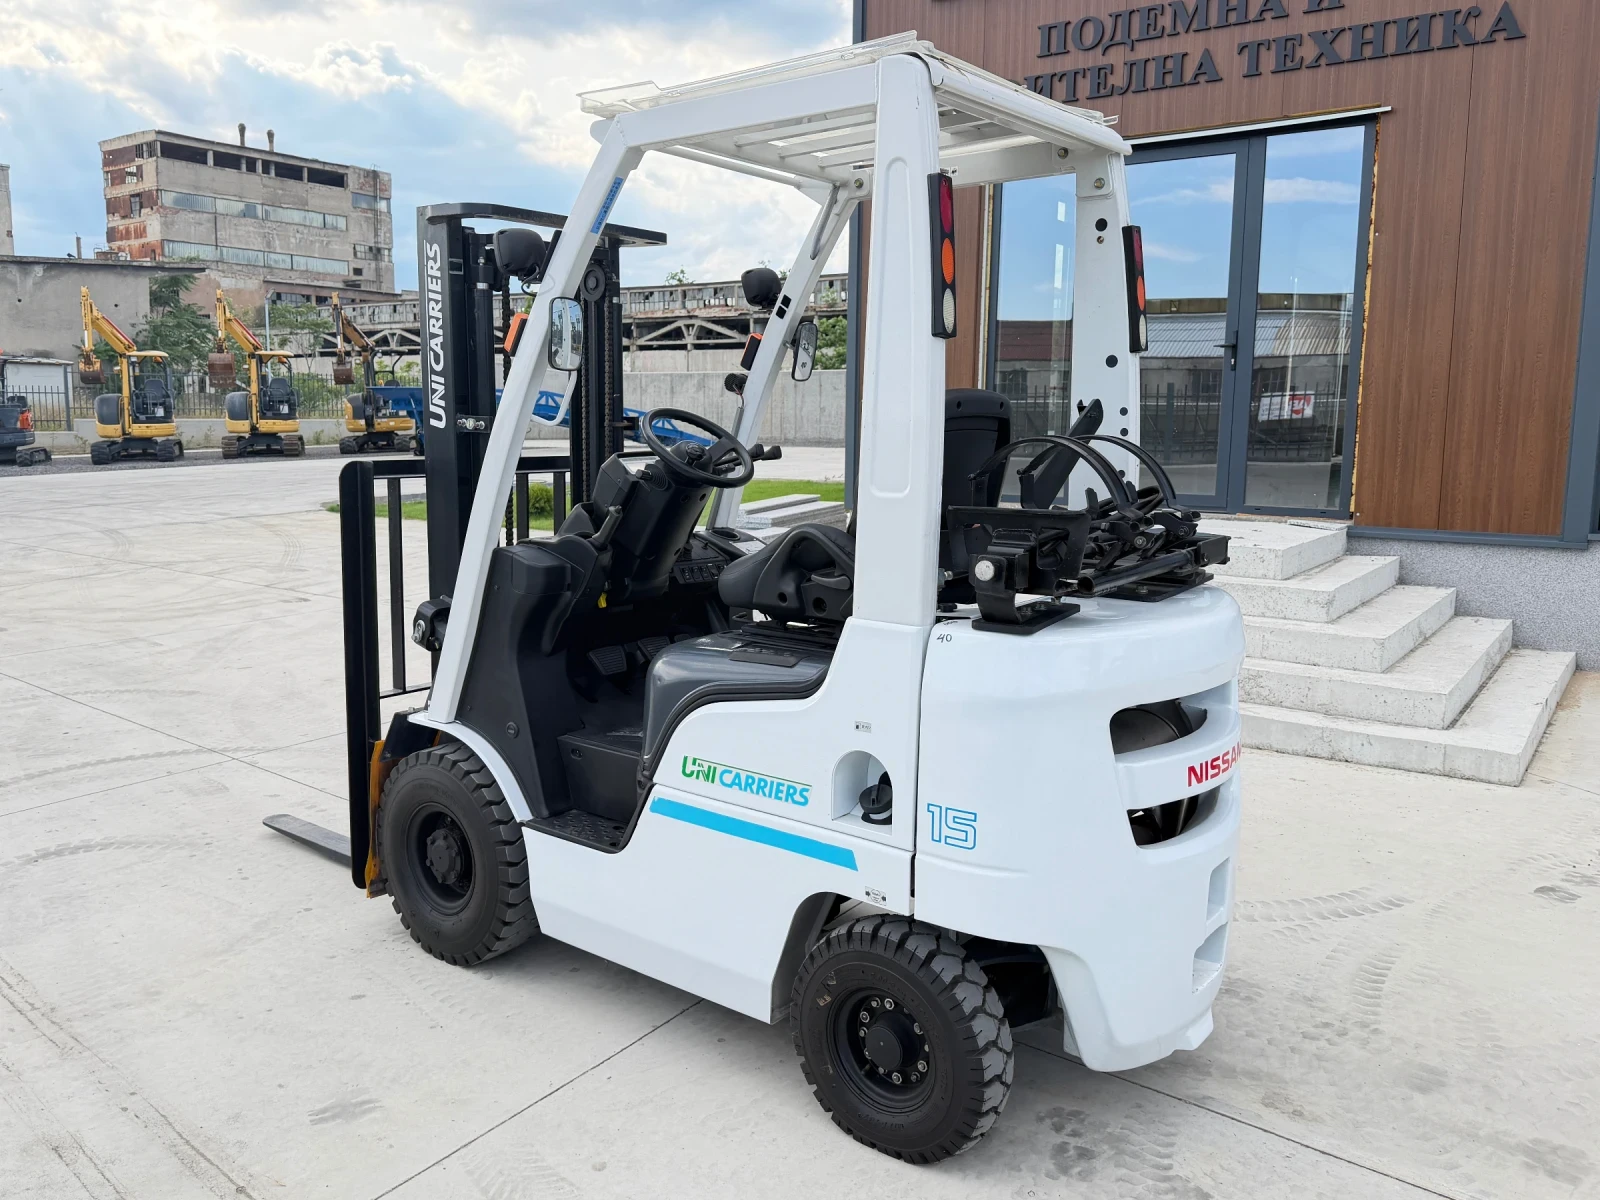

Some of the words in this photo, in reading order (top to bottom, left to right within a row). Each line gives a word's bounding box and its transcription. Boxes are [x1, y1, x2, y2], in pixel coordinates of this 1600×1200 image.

[1007, 48, 1223, 103] ИТЕЛНА
[1237, 1, 1526, 78] ТЕХНИКА
[1036, 0, 1289, 58] ПОДЕМНА
[936, 633, 953, 643] 40
[1187, 741, 1241, 788] NISSAN
[927, 803, 977, 850] 15
